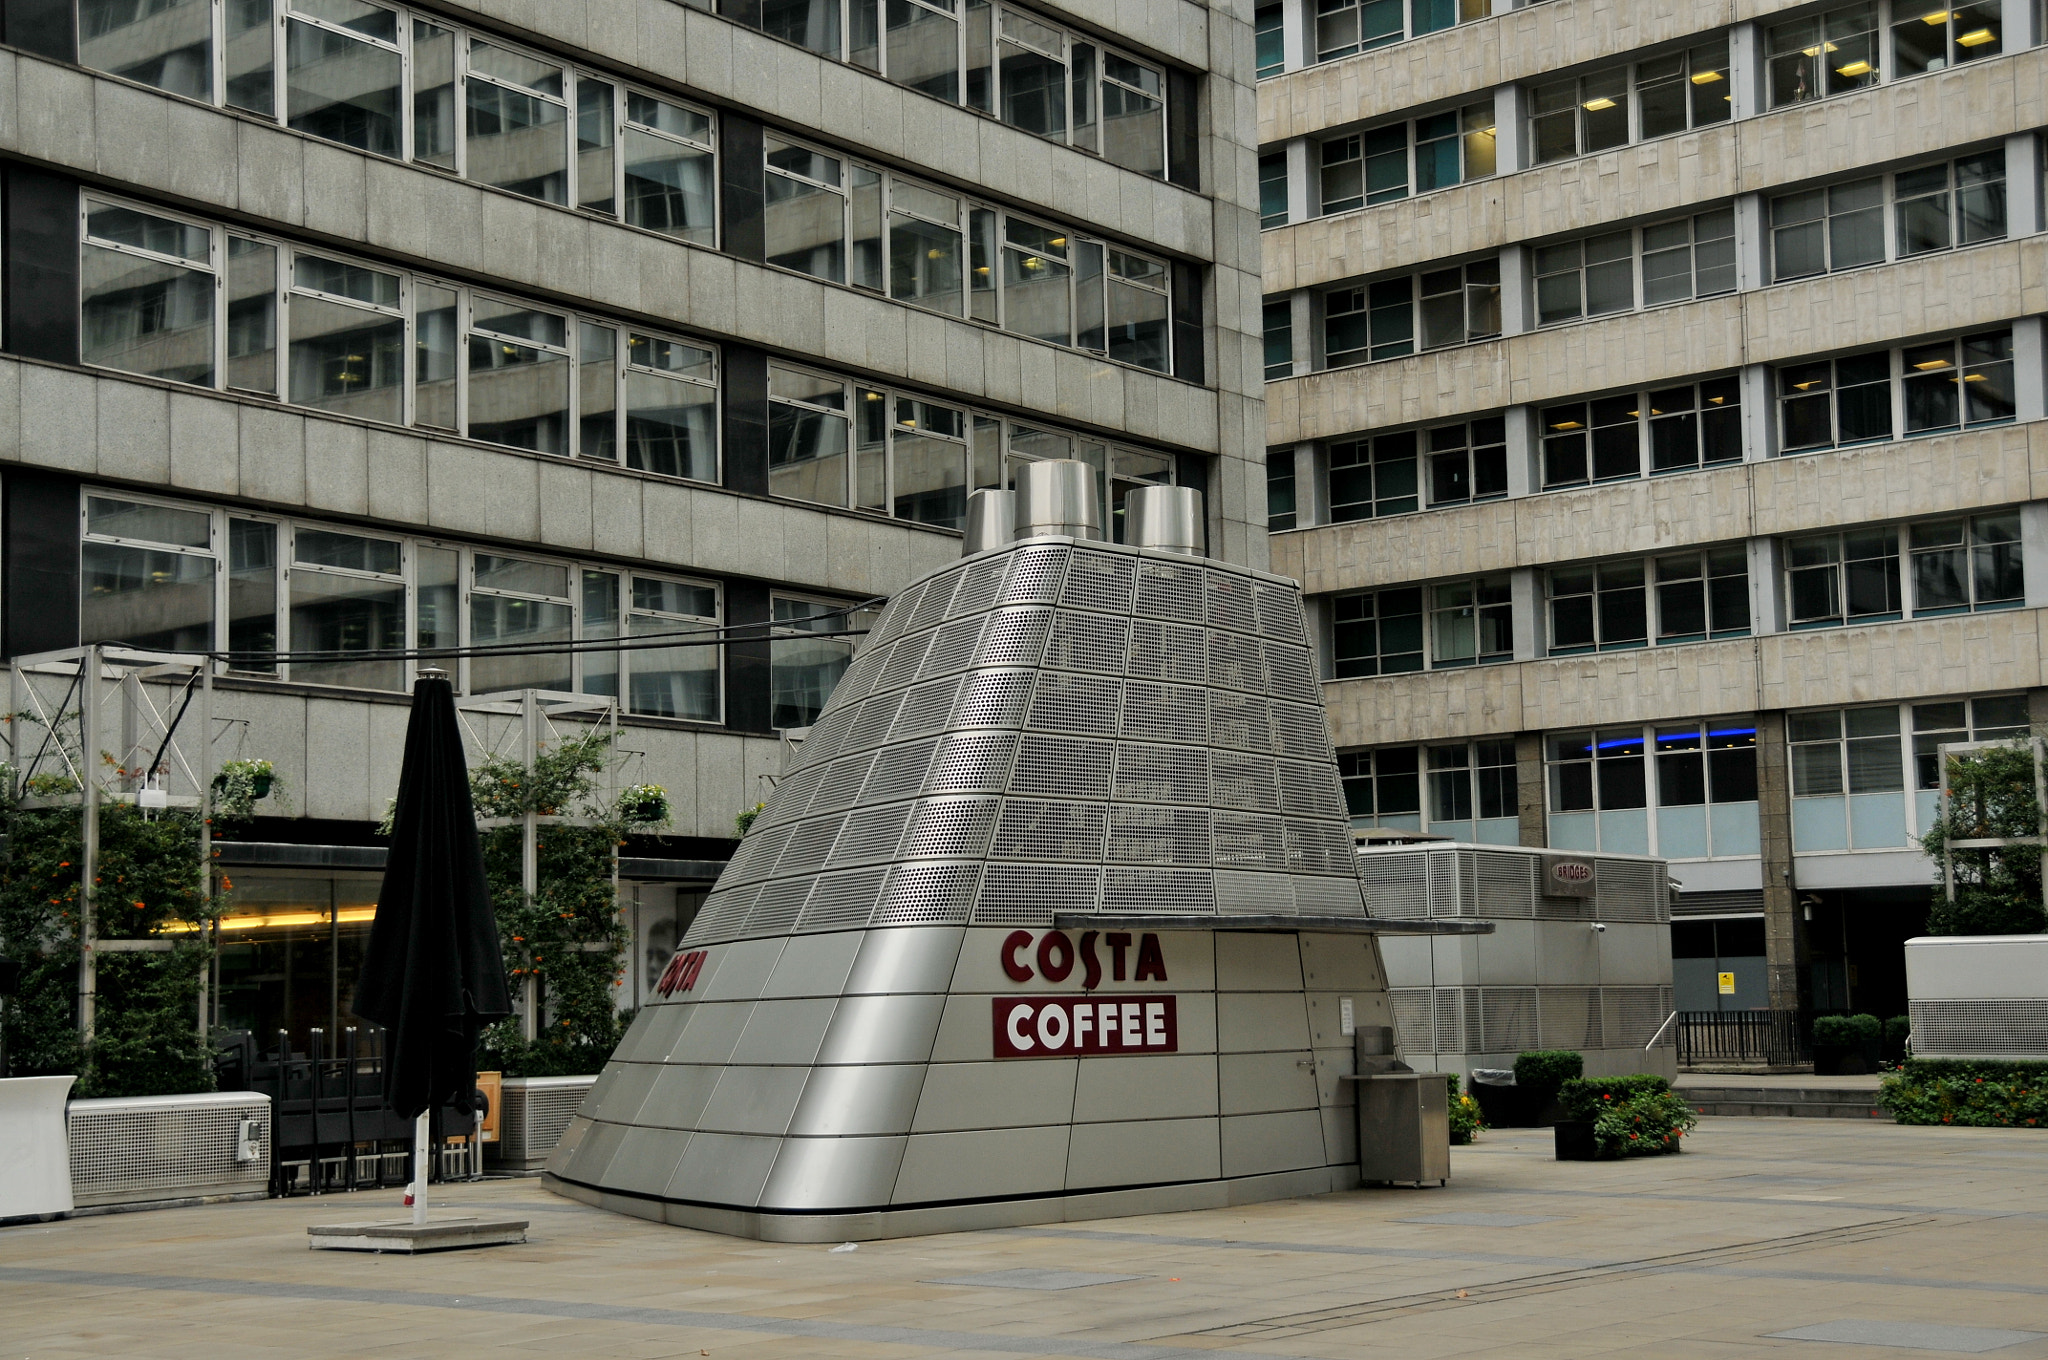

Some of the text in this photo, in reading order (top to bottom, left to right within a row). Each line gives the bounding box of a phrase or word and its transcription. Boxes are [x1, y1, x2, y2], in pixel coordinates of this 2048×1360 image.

[1557, 865, 1589, 879] BRIDGES
[1002, 930, 1168, 990] COSTA
[1007, 1002, 1167, 1050] COFFEE
